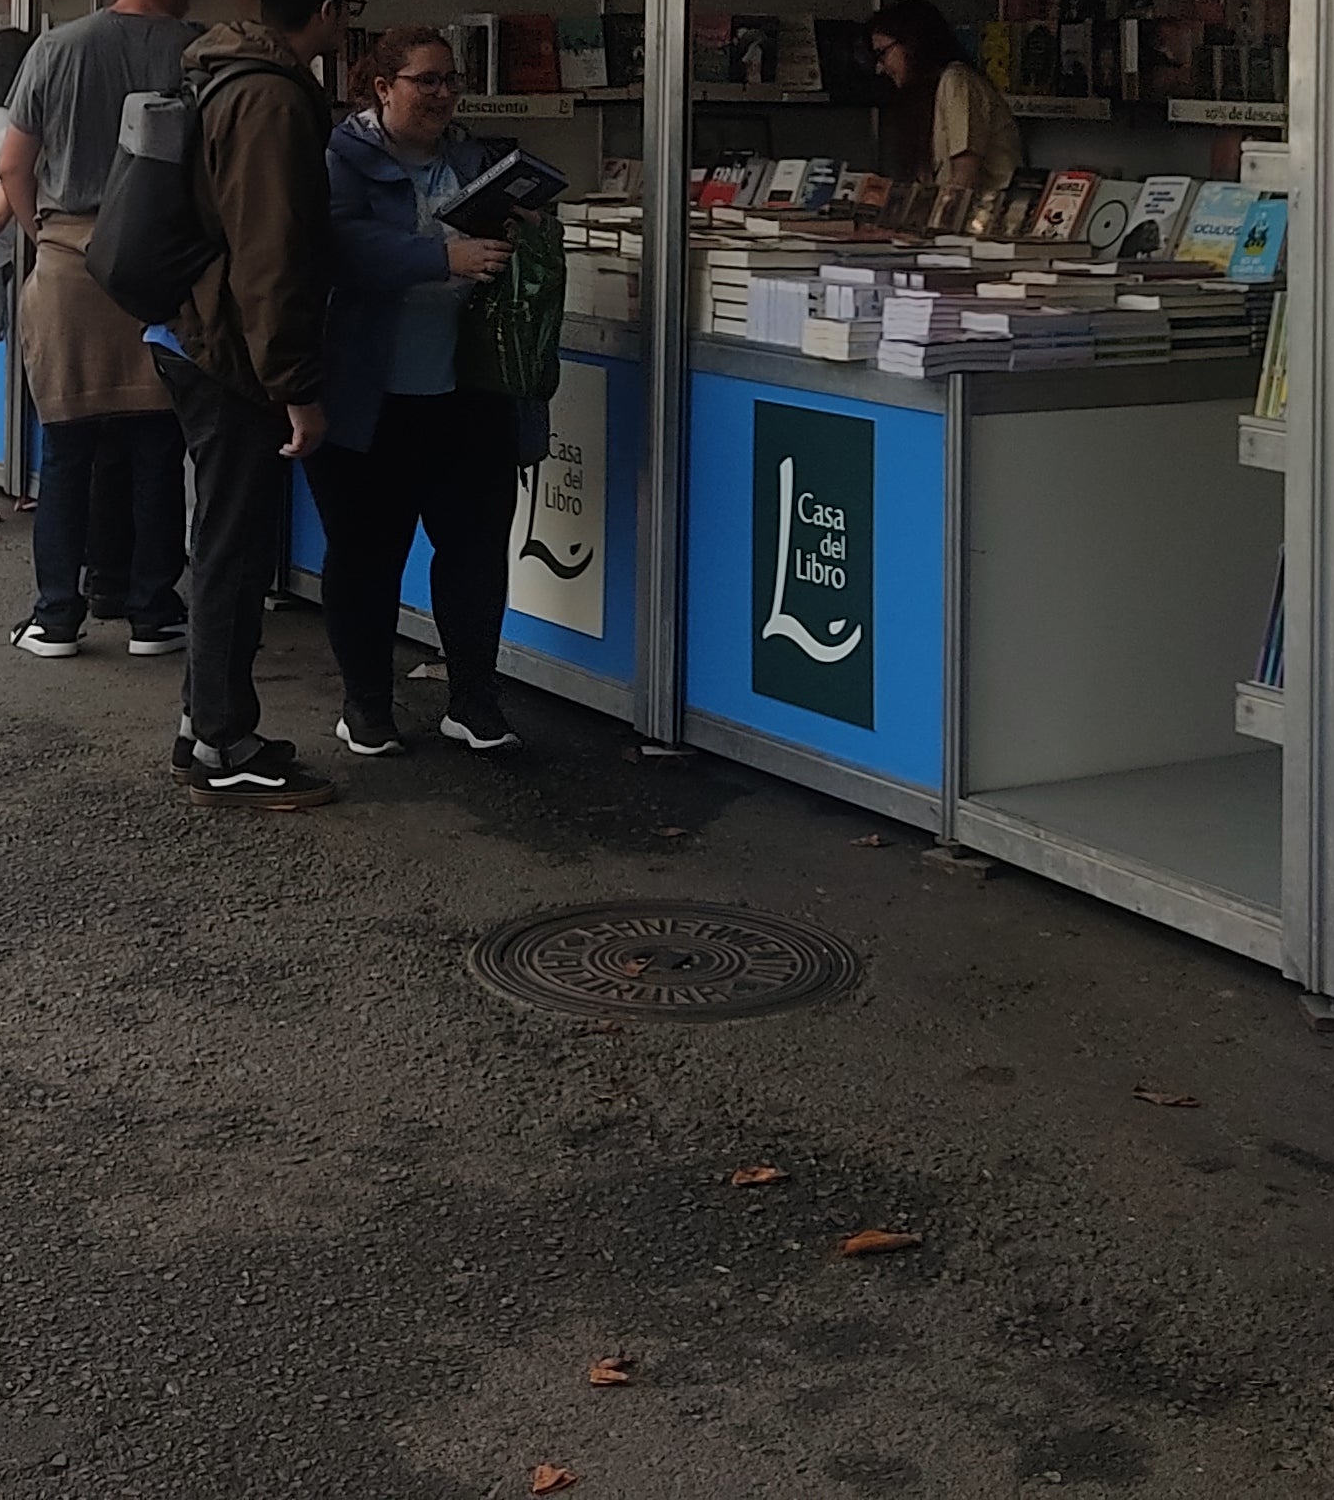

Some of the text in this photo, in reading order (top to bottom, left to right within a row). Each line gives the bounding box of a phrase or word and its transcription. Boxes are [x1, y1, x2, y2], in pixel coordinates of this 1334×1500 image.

[457, 99, 528, 113] descuento
[548, 433, 582, 465] Casa
[564, 467, 583, 490] del
[545, 483, 582, 516] Libro
[798, 493, 846, 531] Casa
[820, 532, 846, 560] del
[795, 548, 846, 590] Libro
